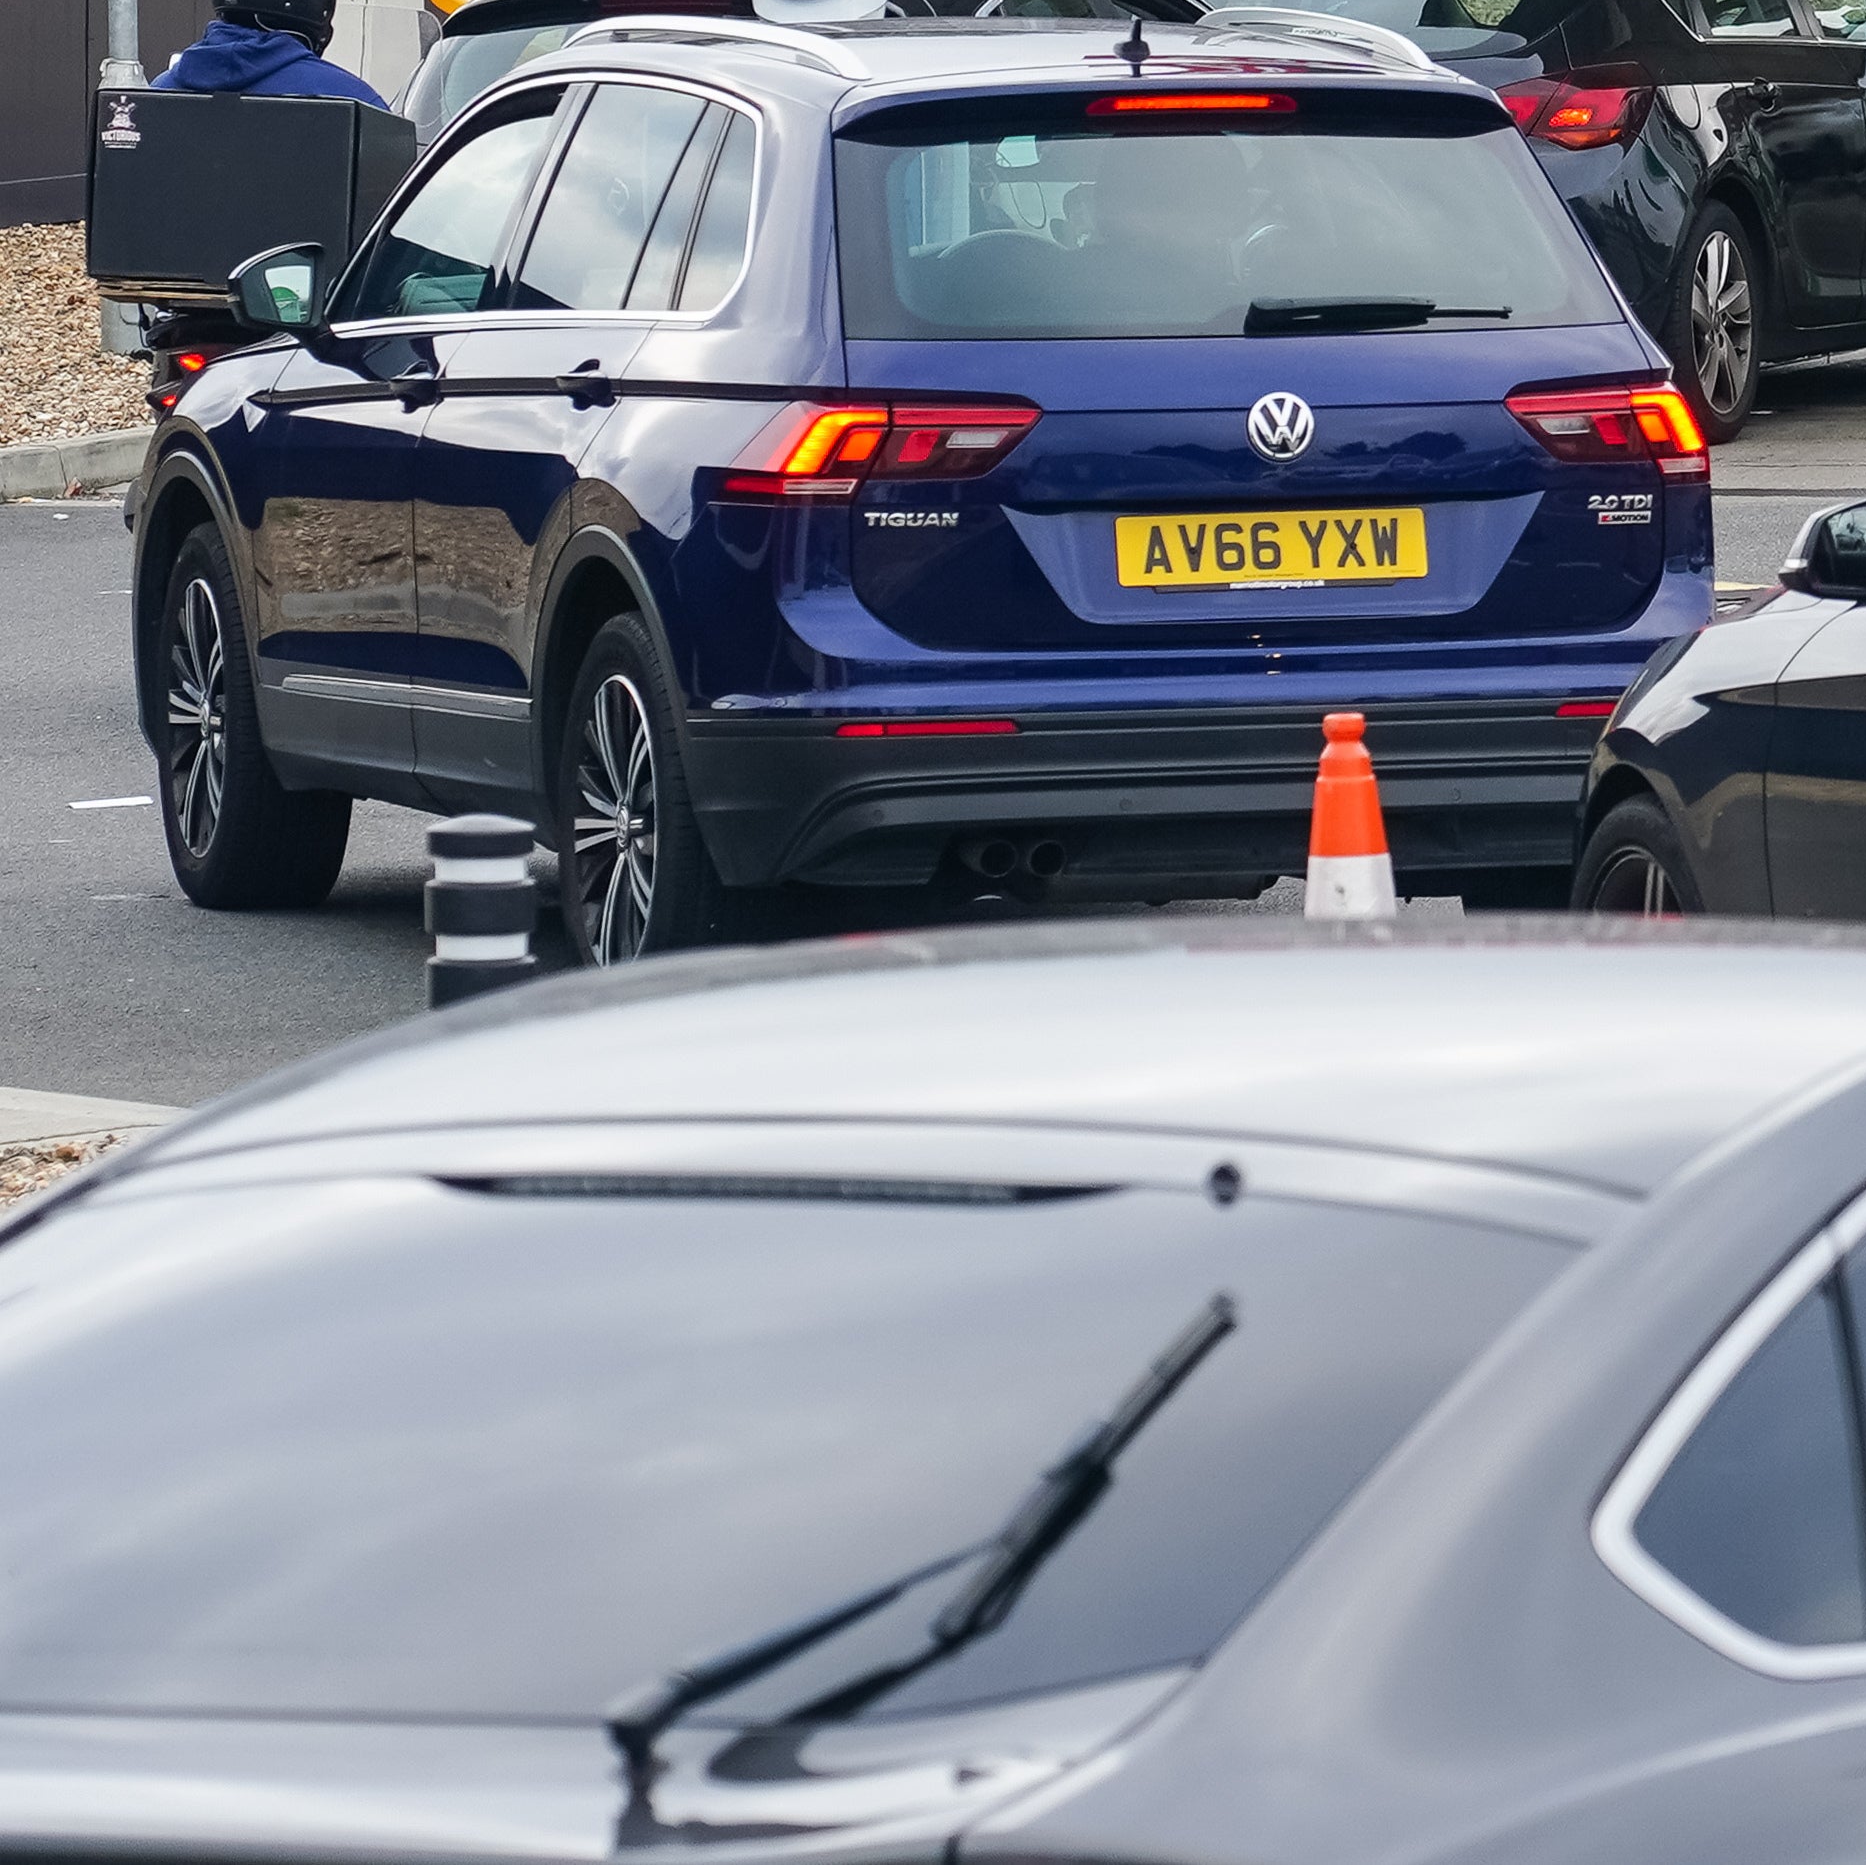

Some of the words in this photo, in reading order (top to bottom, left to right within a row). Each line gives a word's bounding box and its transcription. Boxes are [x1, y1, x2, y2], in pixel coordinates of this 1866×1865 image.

[1620, 494, 1653, 509] TDI
[864, 512, 960, 527] TIGUAN
[1144, 522, 1282, 574] AV66
[1299, 518, 1398, 569] YXW
